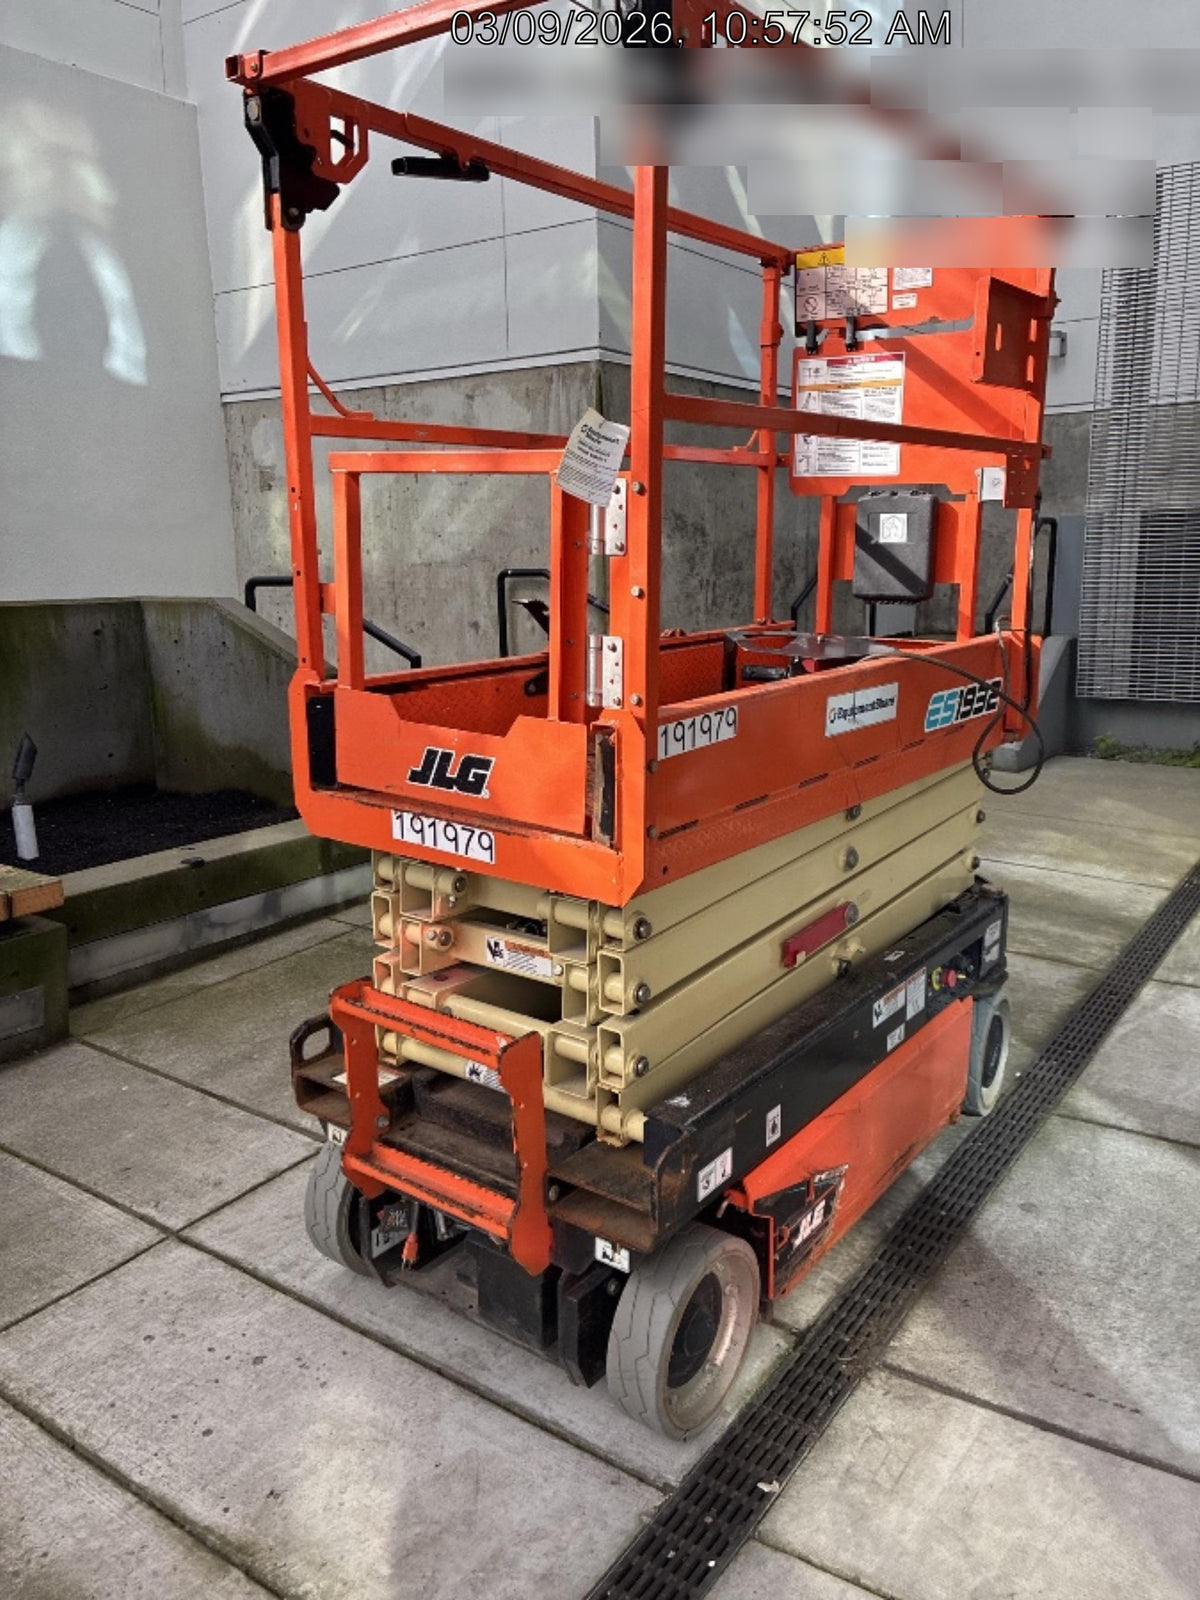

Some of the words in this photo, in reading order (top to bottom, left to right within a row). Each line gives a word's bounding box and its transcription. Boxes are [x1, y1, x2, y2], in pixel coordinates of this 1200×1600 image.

[661, 707, 736, 756] 191979
[407, 746, 495, 796] JLG
[396, 812, 494, 862] 191979
